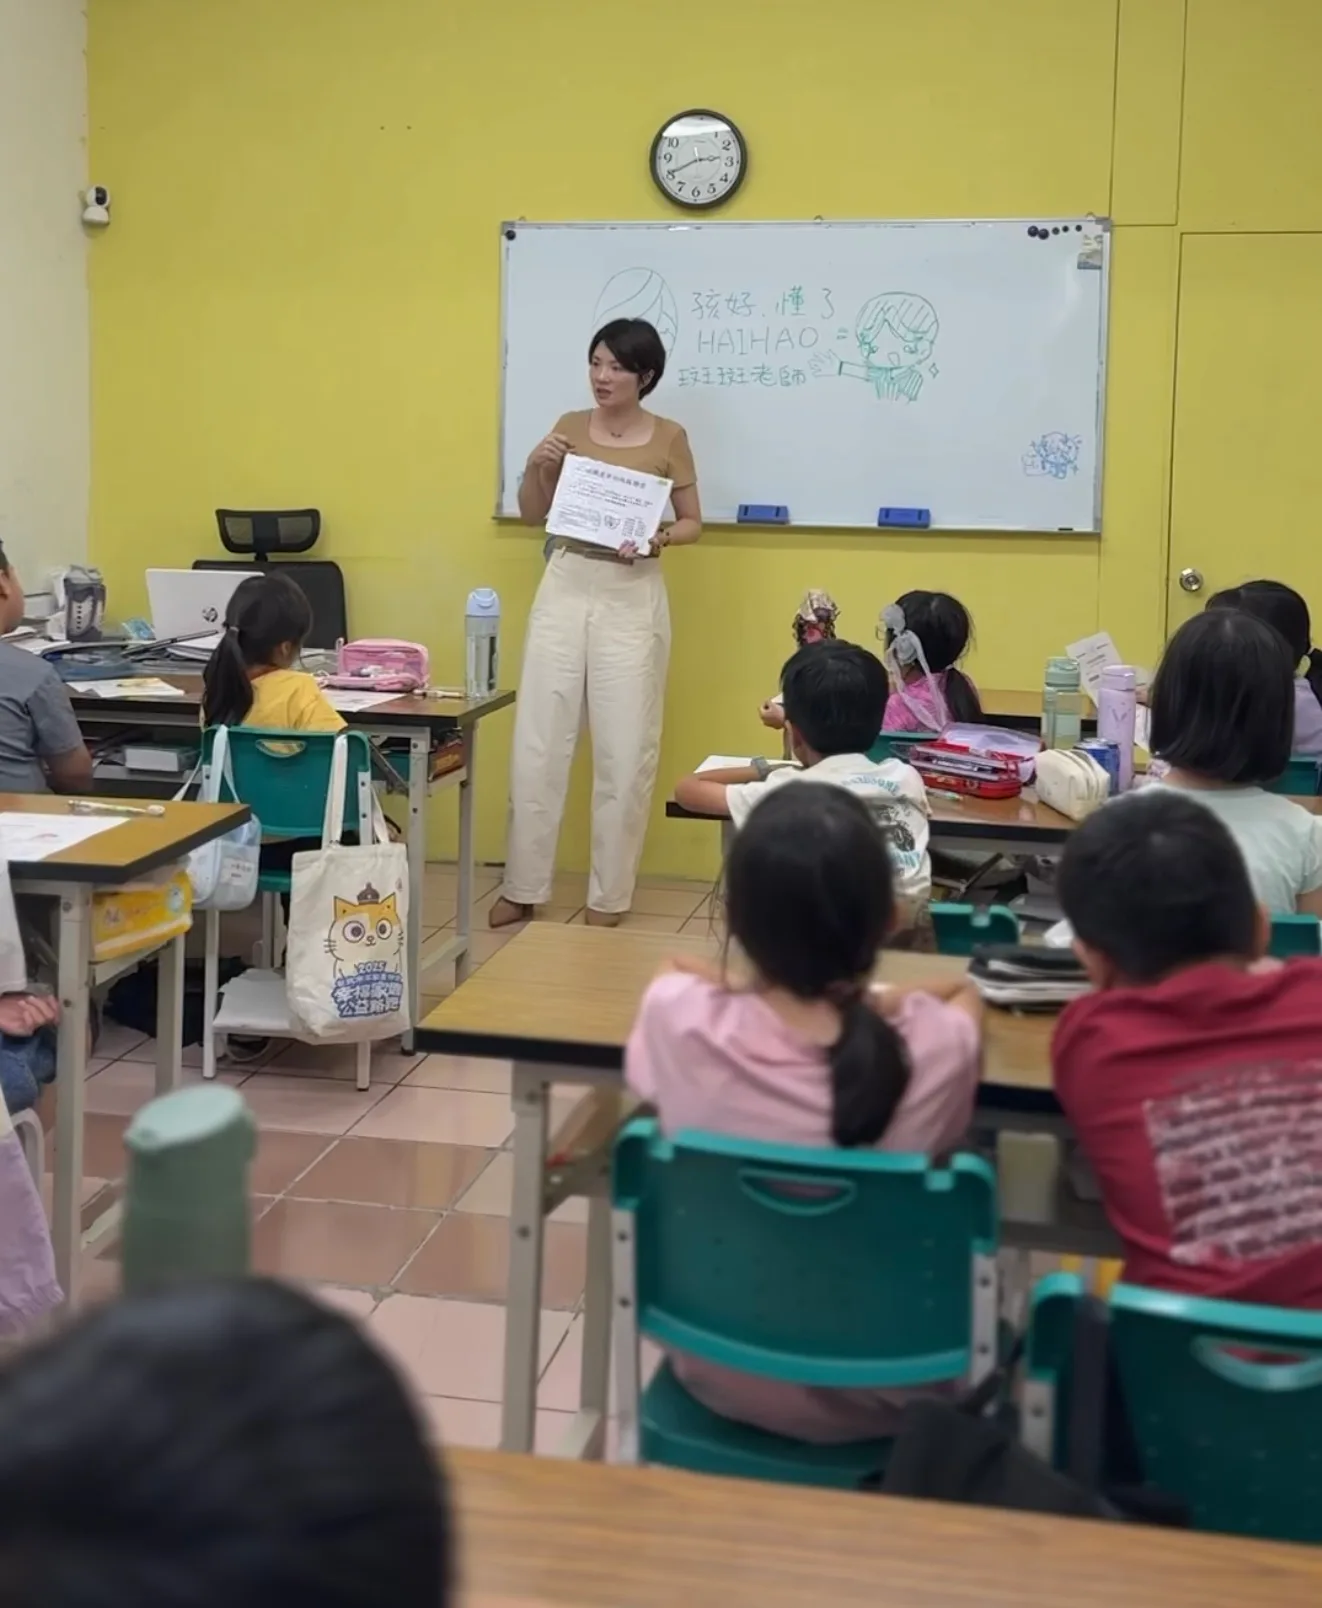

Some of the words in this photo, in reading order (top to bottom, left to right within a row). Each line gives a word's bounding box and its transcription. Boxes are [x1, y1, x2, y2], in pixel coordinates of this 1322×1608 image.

[667, 137, 679, 148] 10
[722, 140, 731, 151] 2
[663, 152, 672, 163] 9
[724, 156, 734, 167] 3
[666, 169, 675, 180] 8
[720, 172, 729, 182] 4
[677, 181, 686, 192] 7
[691, 186, 701, 197] 6
[707, 183, 716, 194] 5
[698, 326, 819, 355] HAIHAO
[357, 960, 387, 974] 2025
